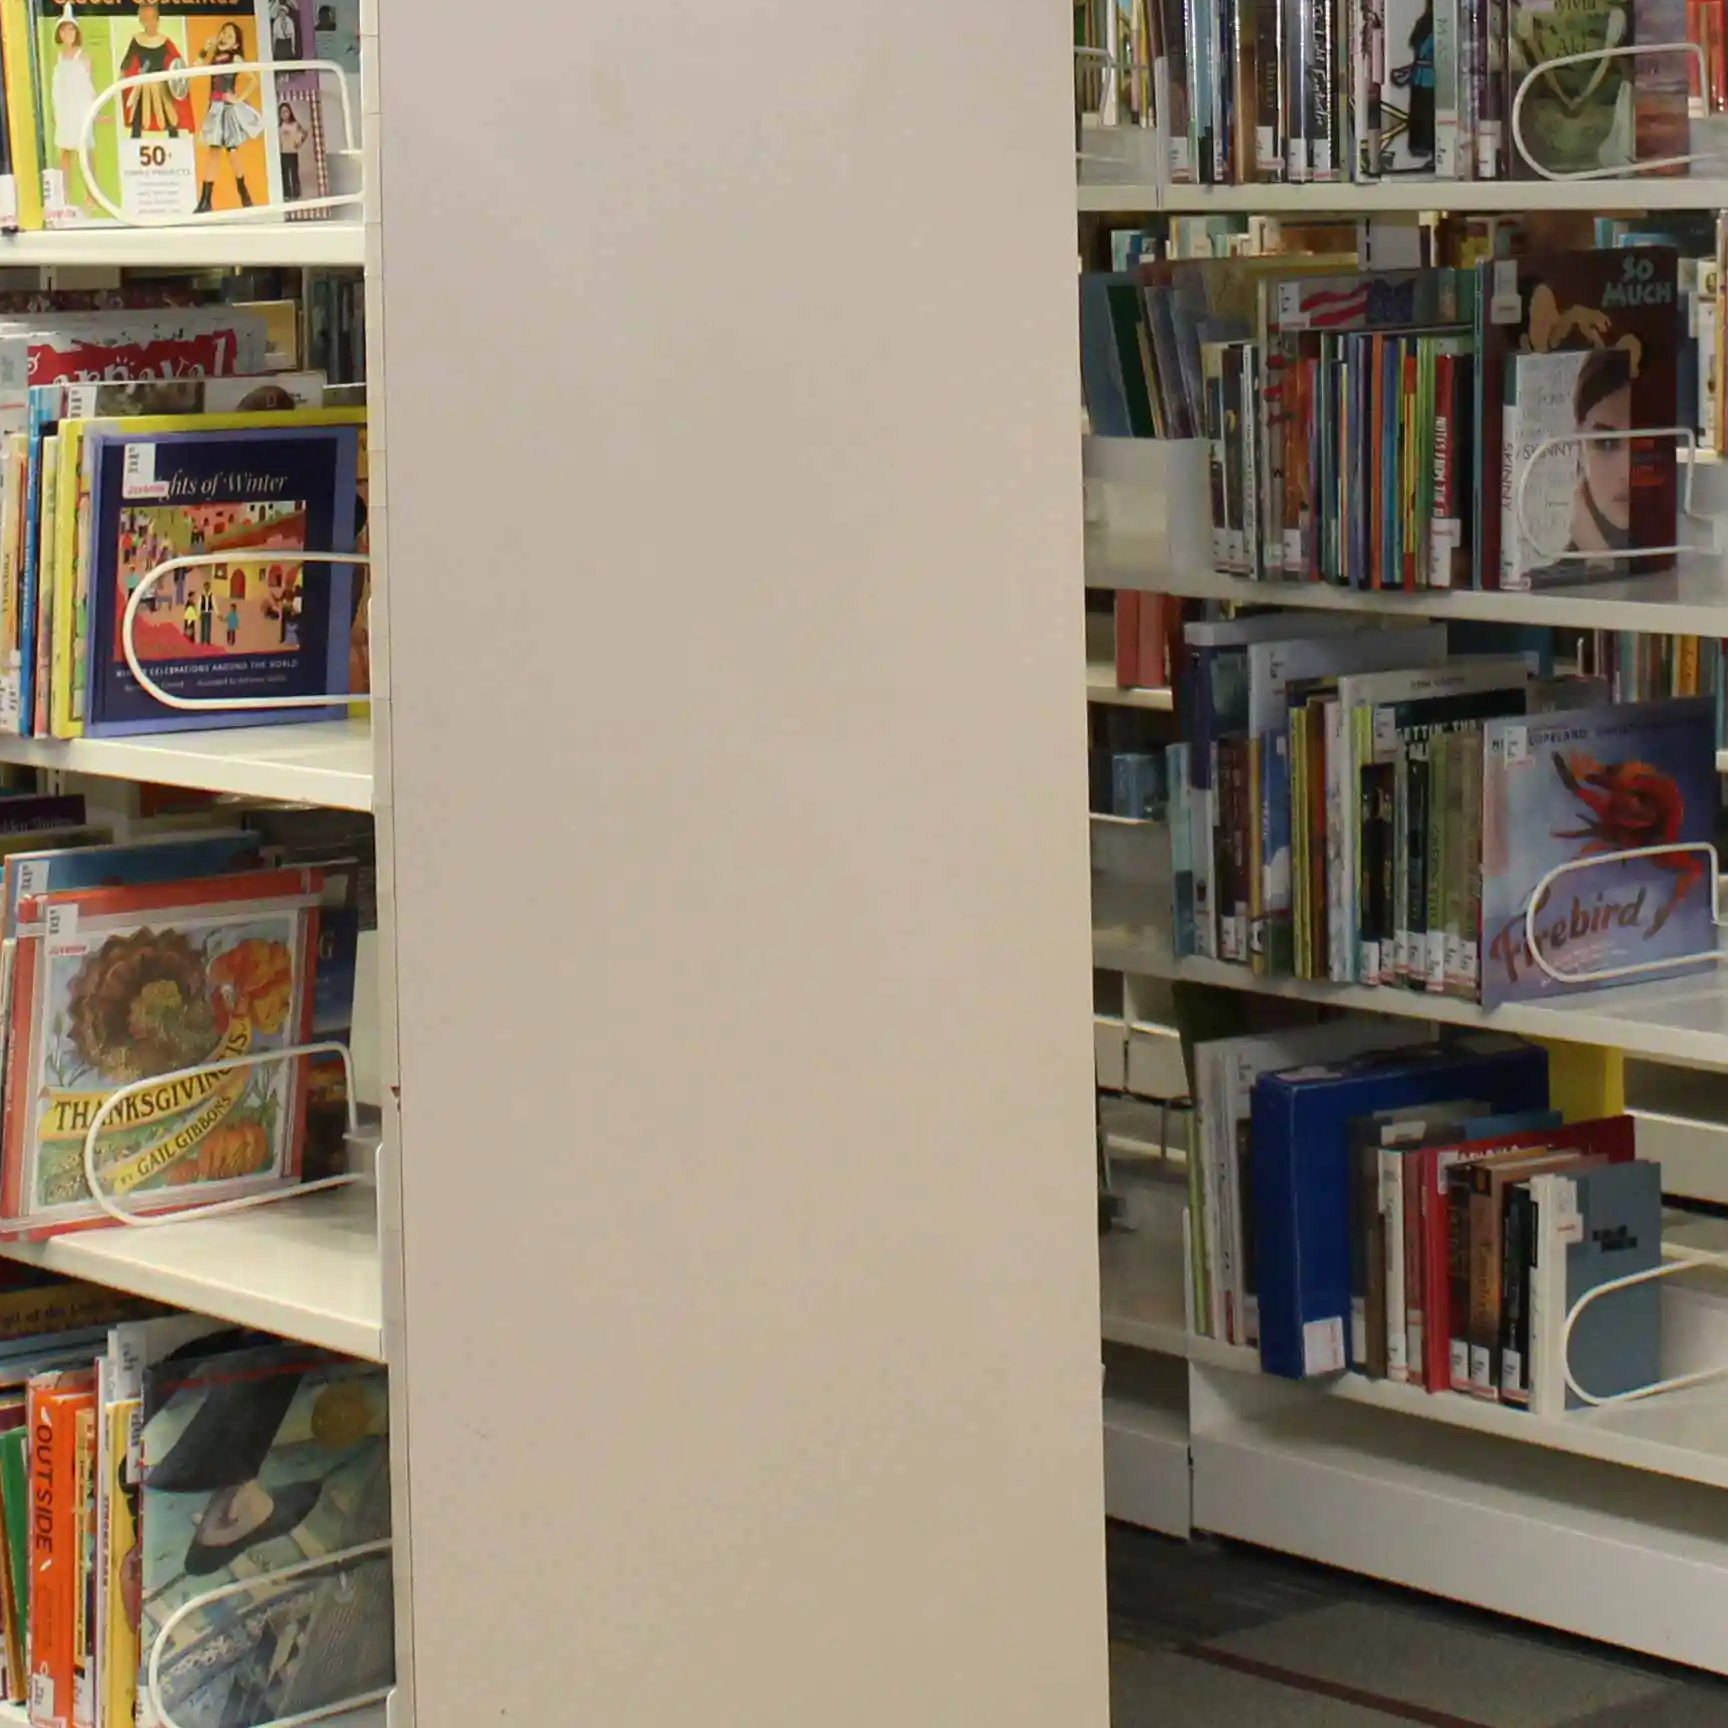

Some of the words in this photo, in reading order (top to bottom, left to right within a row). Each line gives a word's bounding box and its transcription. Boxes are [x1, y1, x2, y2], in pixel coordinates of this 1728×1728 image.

[1602, 282, 1672, 307] MUCH
[1622, 255, 1654, 279] SO
[157, 470, 195, 503] ghts
[201, 472, 220, 500] of
[222, 474, 288, 494] Winter
[1501, 443, 1513, 511] SKINNY
[54, 1050, 234, 1132] THANKSGIVING
[137, 1140, 176, 1176] GAIL
[175, 1097, 230, 1149] GIBBONS
[35, 1424, 54, 1553] OUTSIDE
